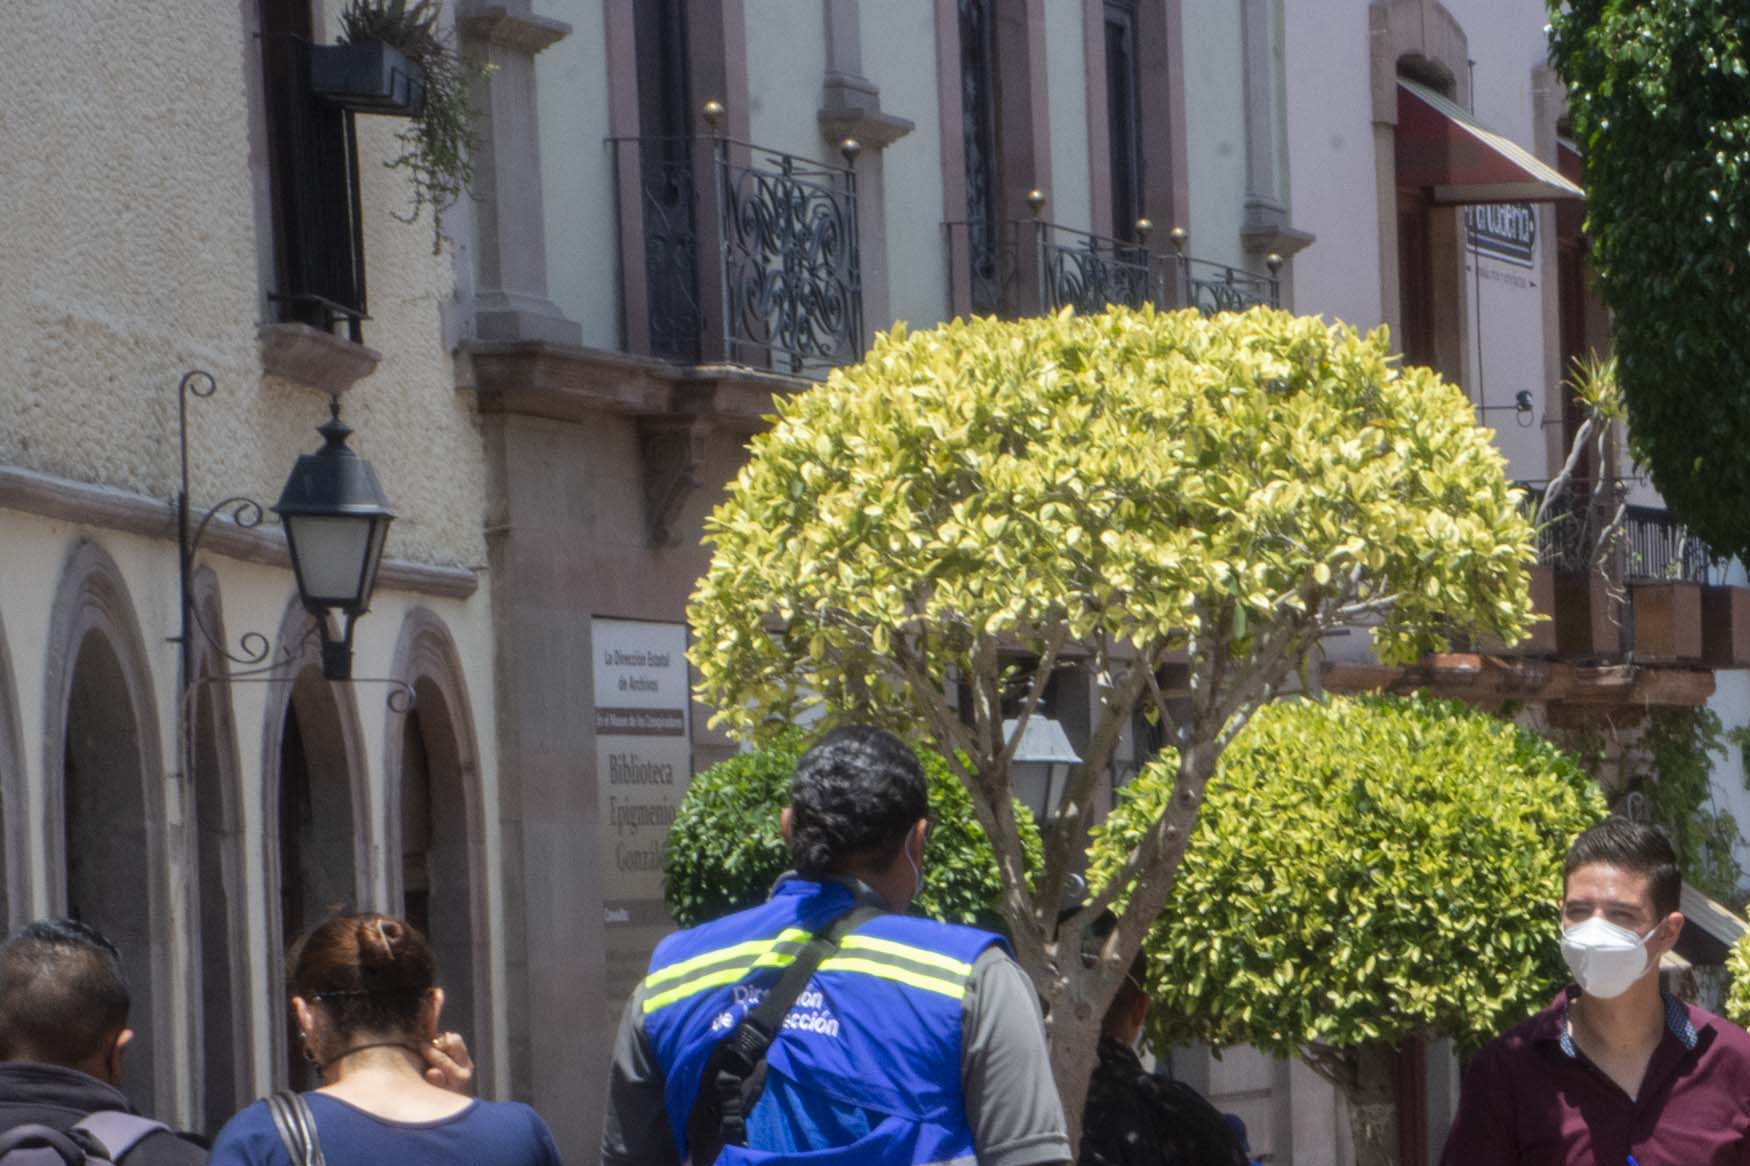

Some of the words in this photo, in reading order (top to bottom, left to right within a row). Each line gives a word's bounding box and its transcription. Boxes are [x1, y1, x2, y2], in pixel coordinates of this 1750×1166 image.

[604, 648, 613, 666] La
[614, 649, 646, 667] Dirección
[618, 675, 627, 692] de
[629, 674, 658, 693] Archivos
[609, 753, 673, 786] Biblioteca
[609, 795, 677, 836] Epigmenio
[616, 840, 664, 874] Gonzál
